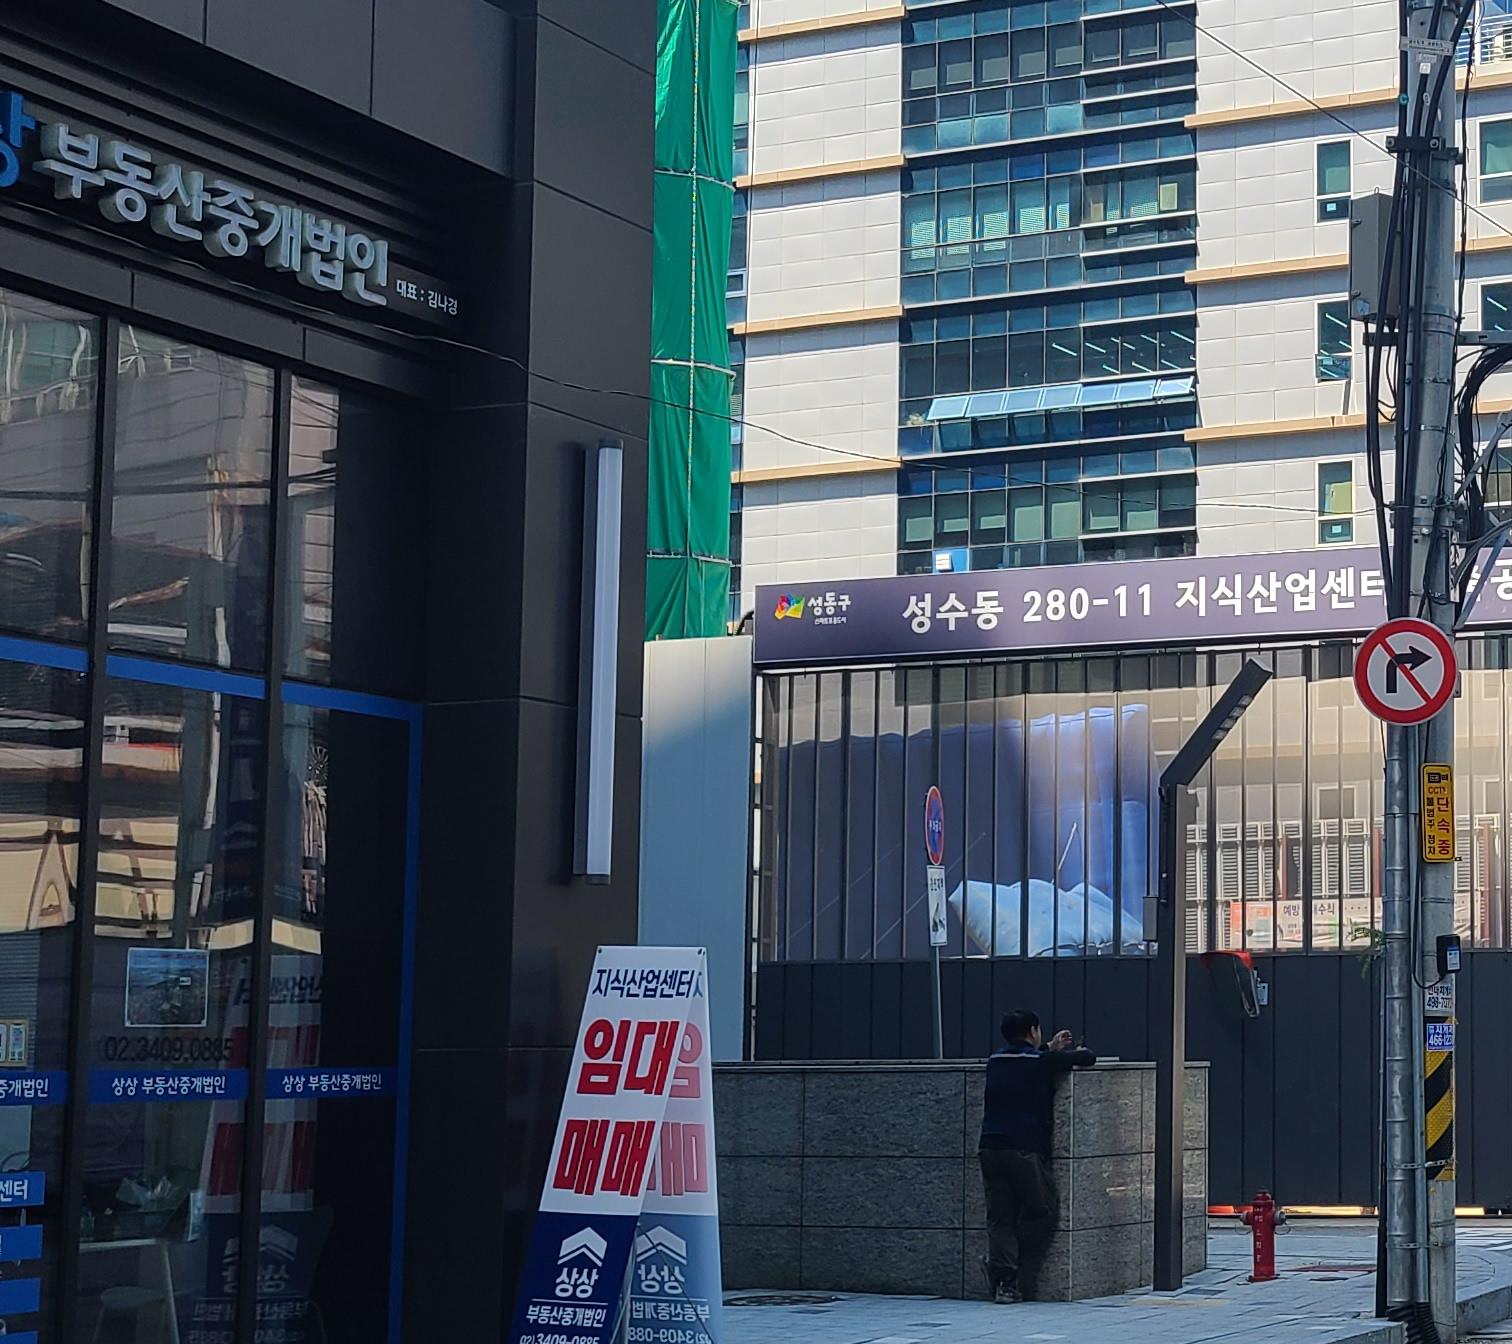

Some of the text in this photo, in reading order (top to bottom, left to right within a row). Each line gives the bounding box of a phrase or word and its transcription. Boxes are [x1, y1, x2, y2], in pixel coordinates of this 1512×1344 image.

[33, 122, 389, 307] 부동산중개법인
[396, 279, 418, 301] 대표
[807, 591, 852, 616] 성동구
[902, 590, 1005, 634] 성수동
[1022, 582, 1153, 624] 280-11
[1174, 564, 1388, 611] 지식산업센터
[591, 968, 695, 999] 지식산업센터
[105, 1037, 232, 1063] 02.3409.0885
[576, 1018, 681, 1096] 임대
[111, 1075, 226, 1096] 상상 부동산중개법인
[282, 1073, 383, 1093] 상상 부동산중개법인
[552, 1118, 656, 1197] 매매
[554, 1267, 600, 1299] 상상
[525, 1304, 608, 1328] 부동산중개법인
